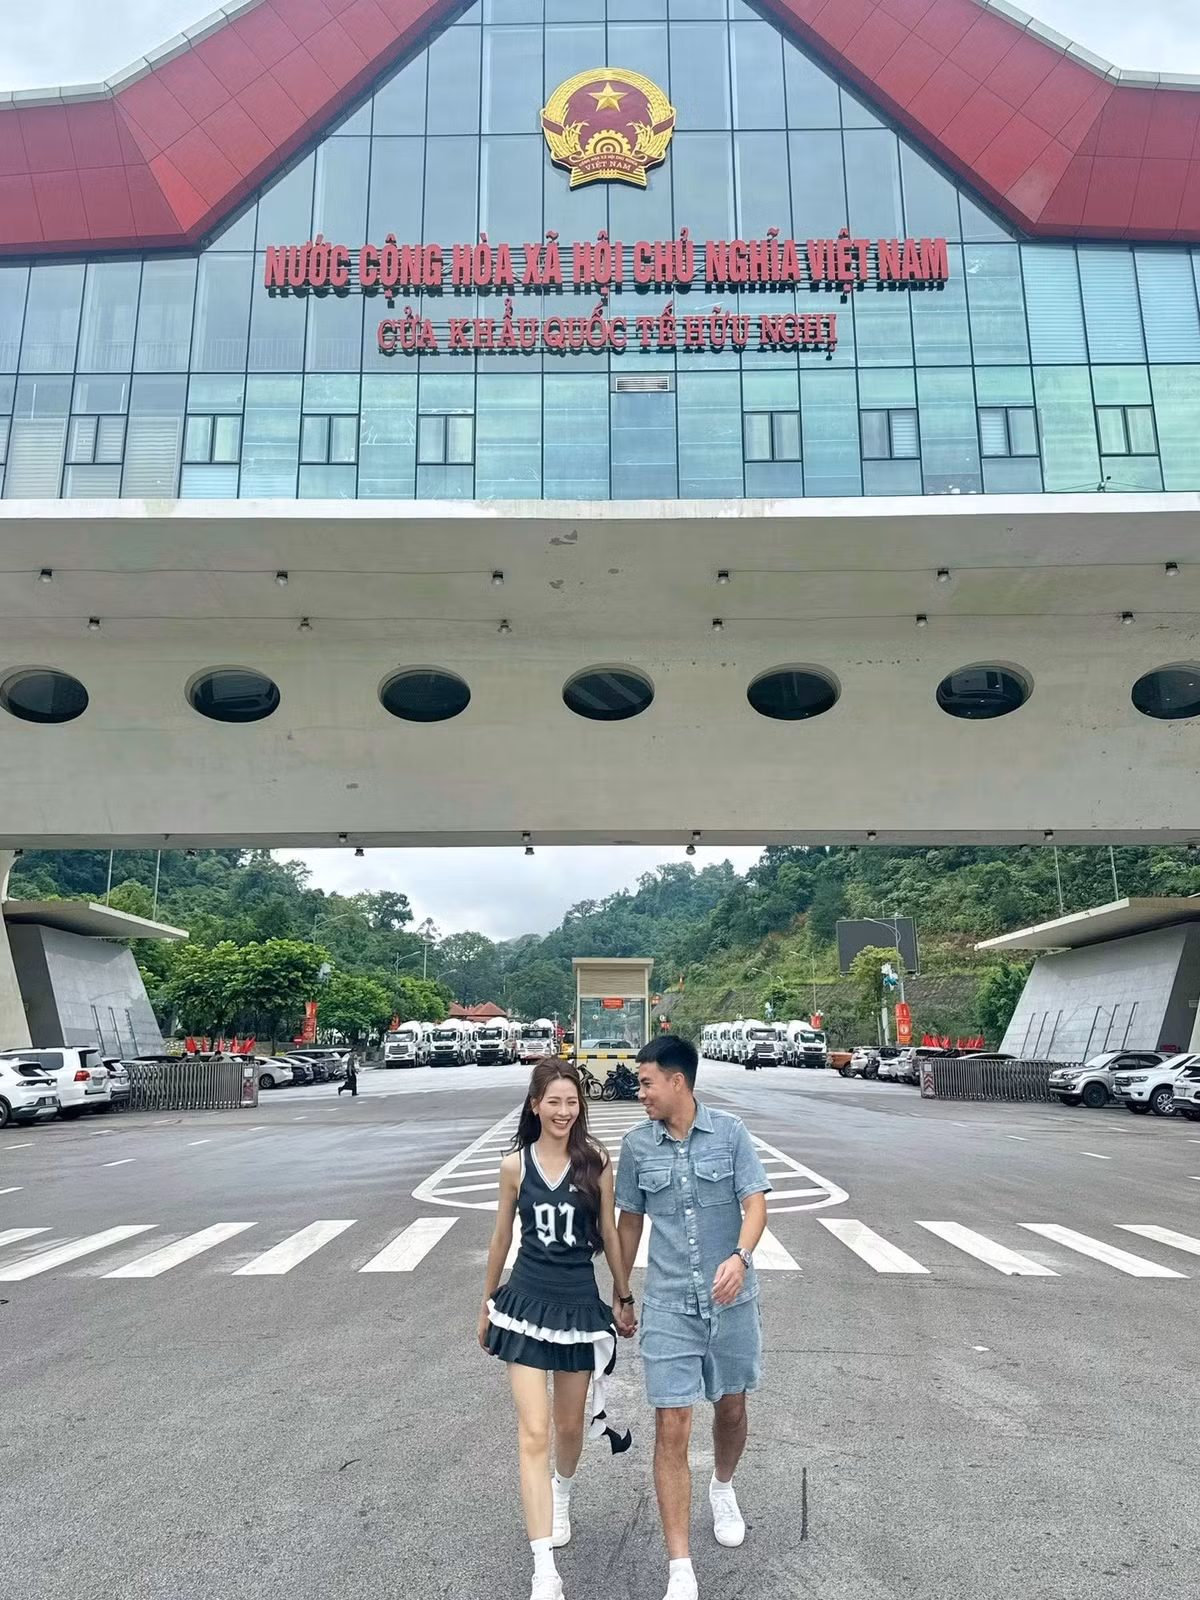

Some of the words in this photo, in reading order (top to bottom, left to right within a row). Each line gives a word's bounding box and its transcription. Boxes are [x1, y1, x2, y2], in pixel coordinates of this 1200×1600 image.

[585, 161, 607, 171] VIỆT
[610, 161, 632, 171] NAM
[264, 234, 349, 288] NƯỚC
[359, 233, 442, 299] CỘNG
[452, 232, 514, 286] HÒA
[523, 230, 562, 285] XÃ
[572, 230, 623, 296] HỘI
[633, 227, 694, 284] CHỦ
[705, 227, 801, 282] NGHĨA
[807, 228, 870, 293] VIỆT
[878, 238, 949, 282] NAM
[377, 305, 438, 350] CỬA
[448, 297, 539, 348] KHẨU
[543, 302, 627, 348] QUỐC
[636, 300, 677, 347] TẾ
[684, 306, 750, 347] HỮU
[759, 313, 837, 352] NGHỊ
[533, 1201, 576, 1247] 91
